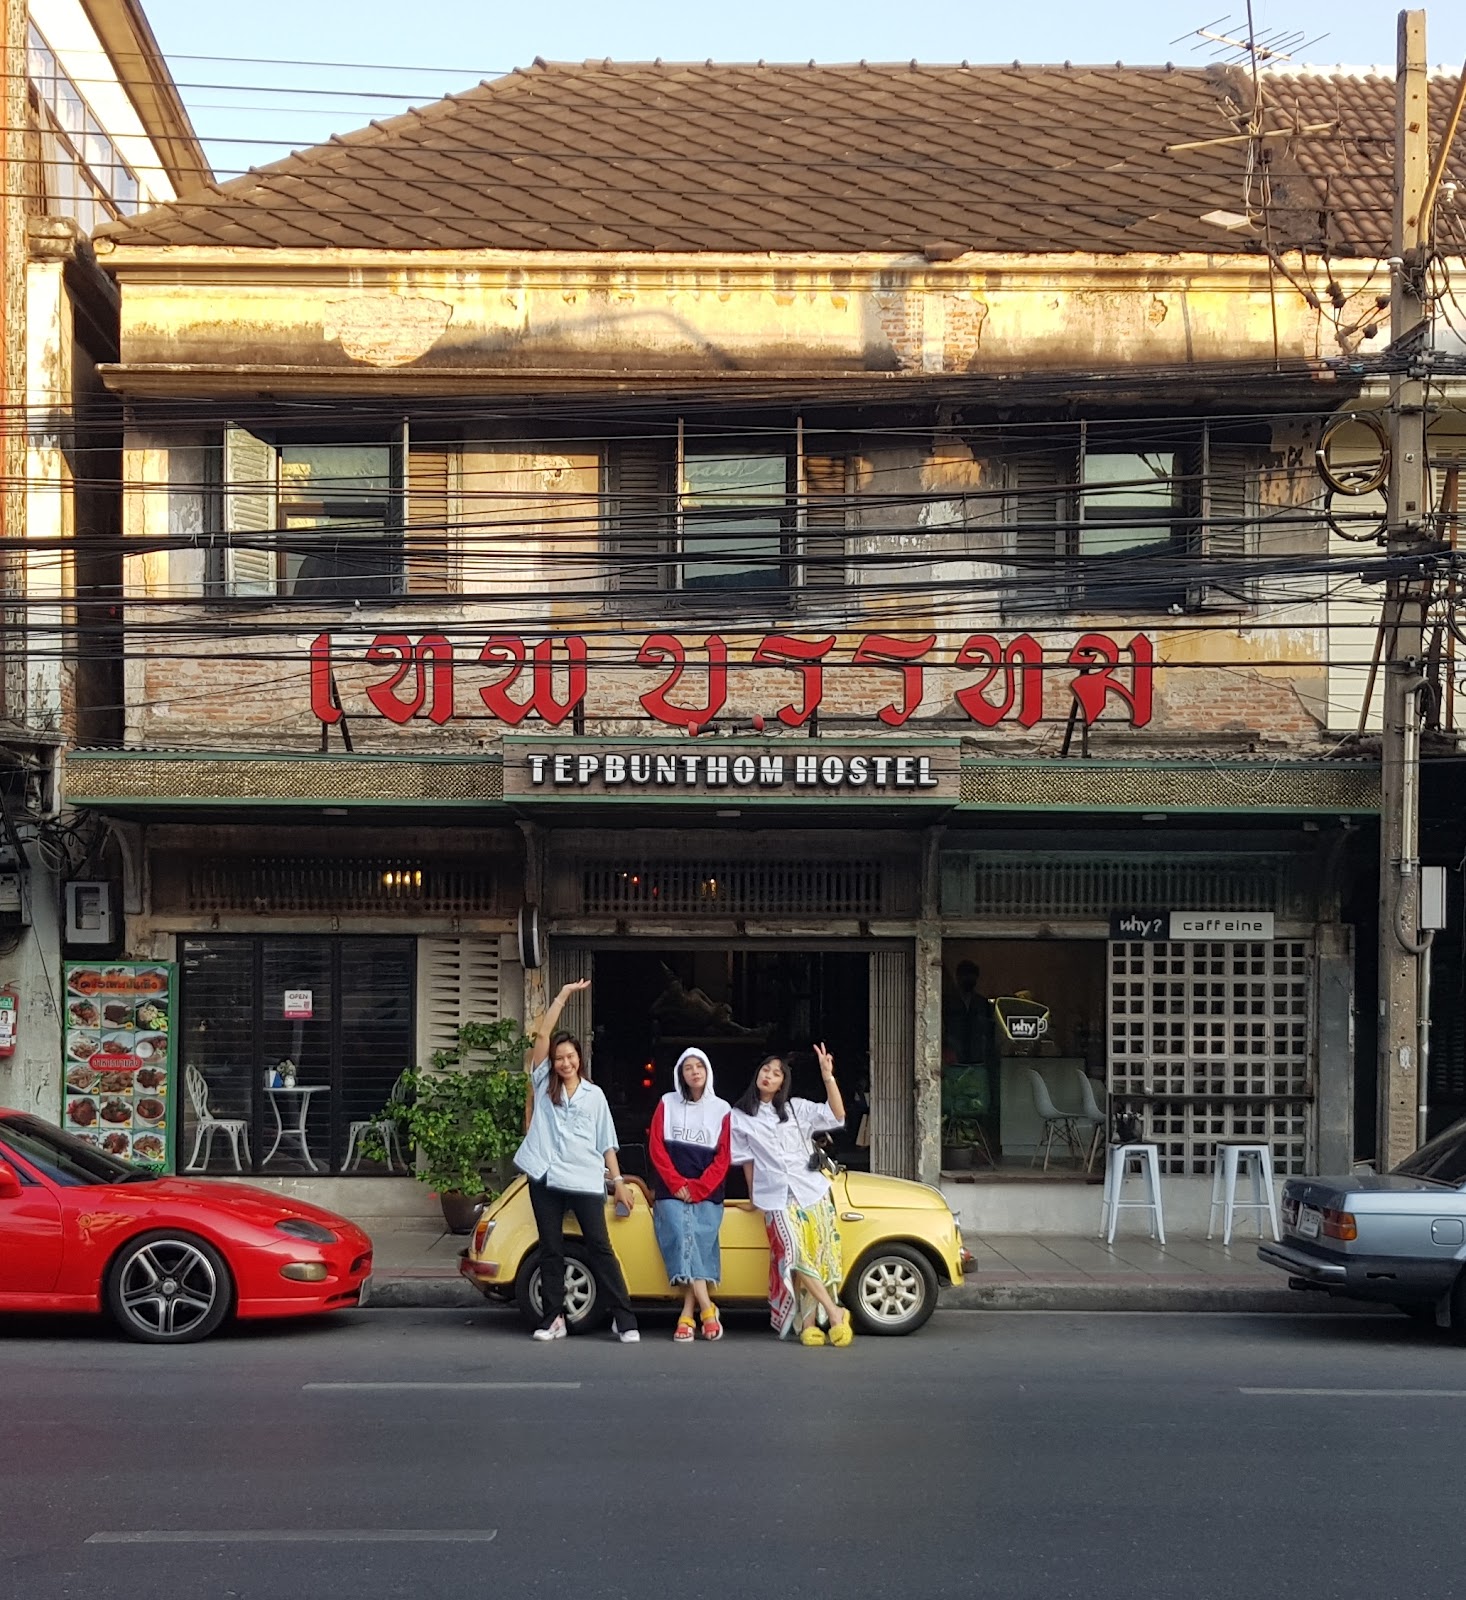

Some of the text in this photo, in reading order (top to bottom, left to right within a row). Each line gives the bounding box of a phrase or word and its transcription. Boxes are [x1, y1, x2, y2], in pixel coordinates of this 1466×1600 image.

[527, 754, 938, 788] TEPBUNTHOM HOSTEL
[1119, 915, 1263, 937] why? caffeine
[672, 1126, 706, 1144] FILA
